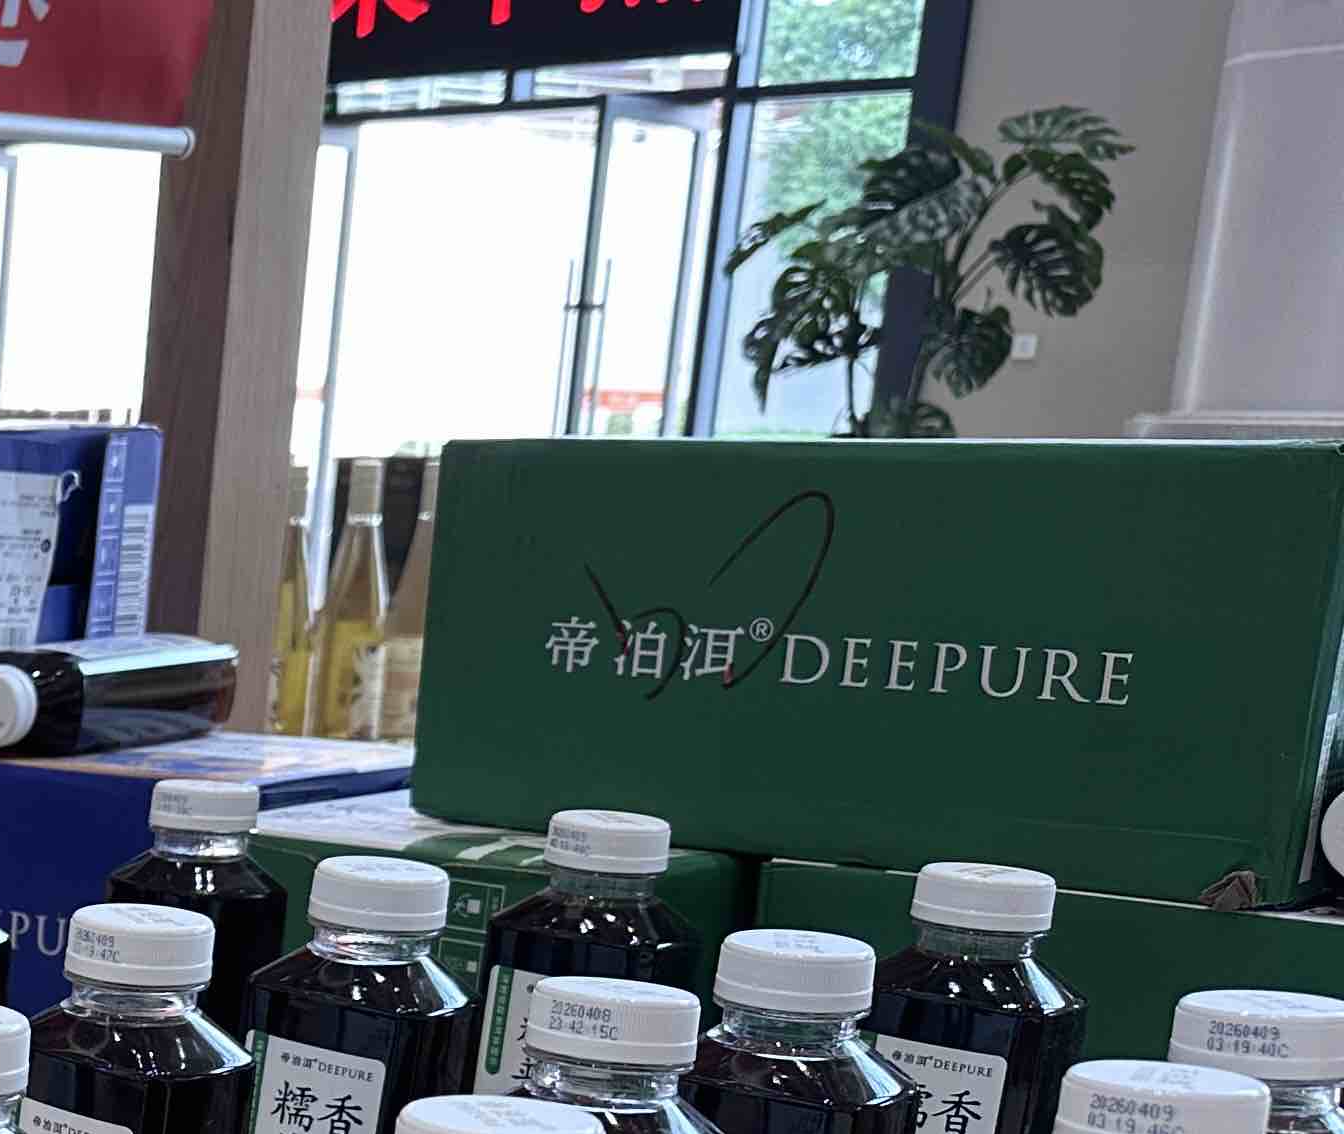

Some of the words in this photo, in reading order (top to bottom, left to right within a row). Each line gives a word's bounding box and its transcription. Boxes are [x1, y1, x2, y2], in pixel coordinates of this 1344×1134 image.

[779, 633, 1135, 706] DEEPURE
[1208, 1019, 1281, 1041] 20260409
[317, 1060, 376, 1083] DEEPURE
[933, 1057, 994, 1079] DEEPURE
[1089, 1093, 1175, 1121] 20260409
